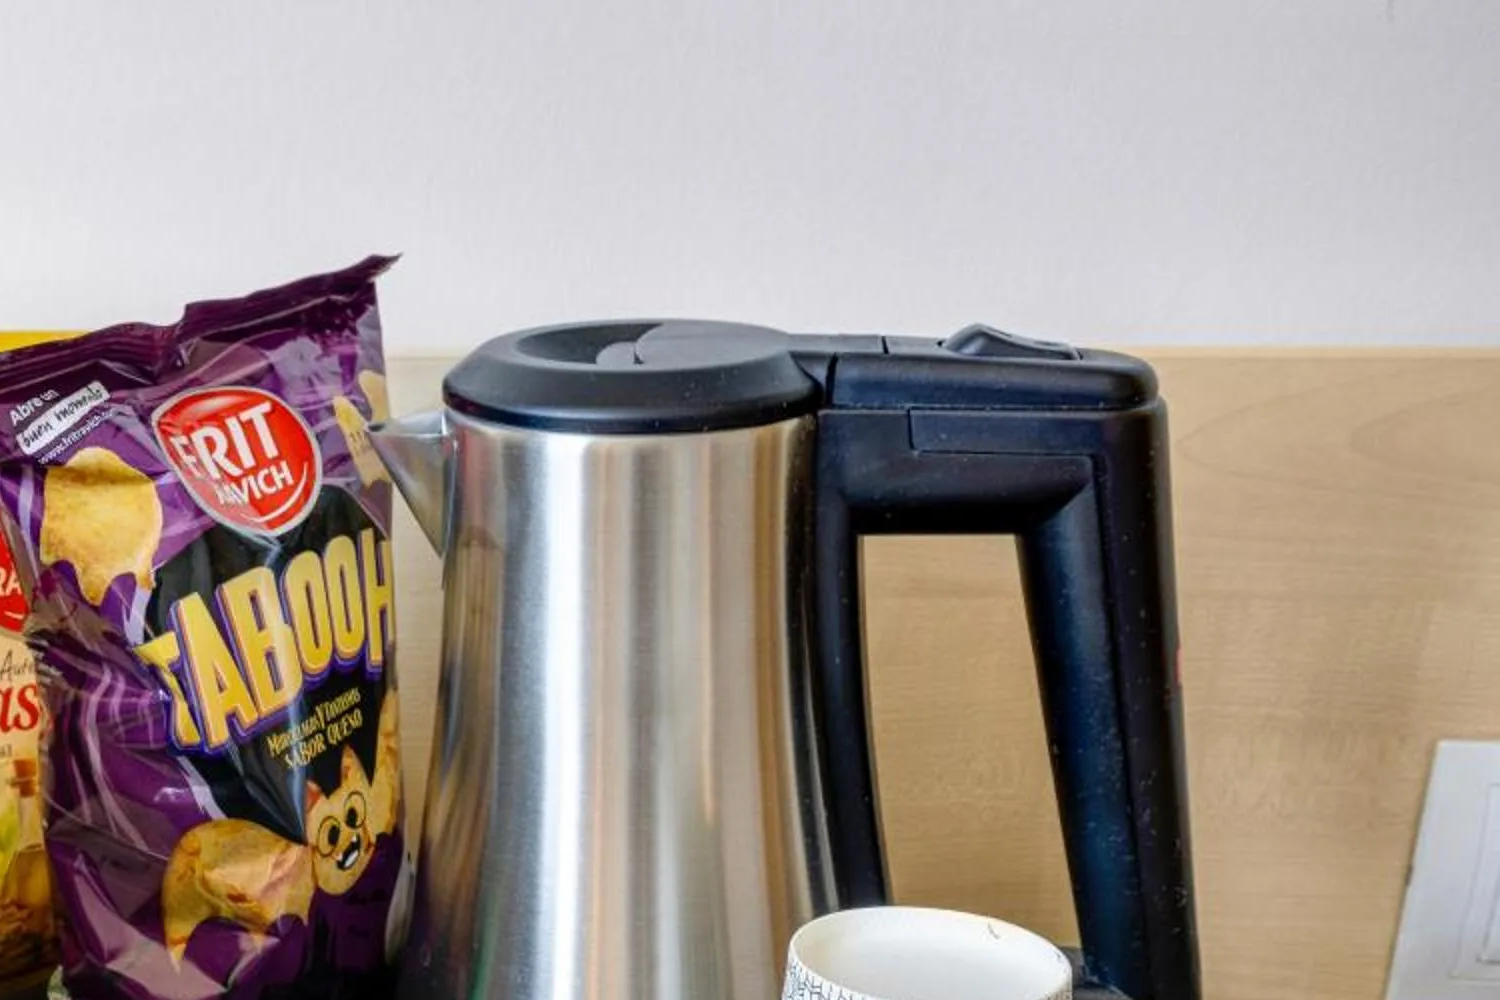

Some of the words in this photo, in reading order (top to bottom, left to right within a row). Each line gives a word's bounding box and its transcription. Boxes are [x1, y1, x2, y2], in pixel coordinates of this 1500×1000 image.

[10, 396, 43, 427] Abre
[169, 401, 280, 480] FRIT
[132, 527, 394, 749] TABOOH
